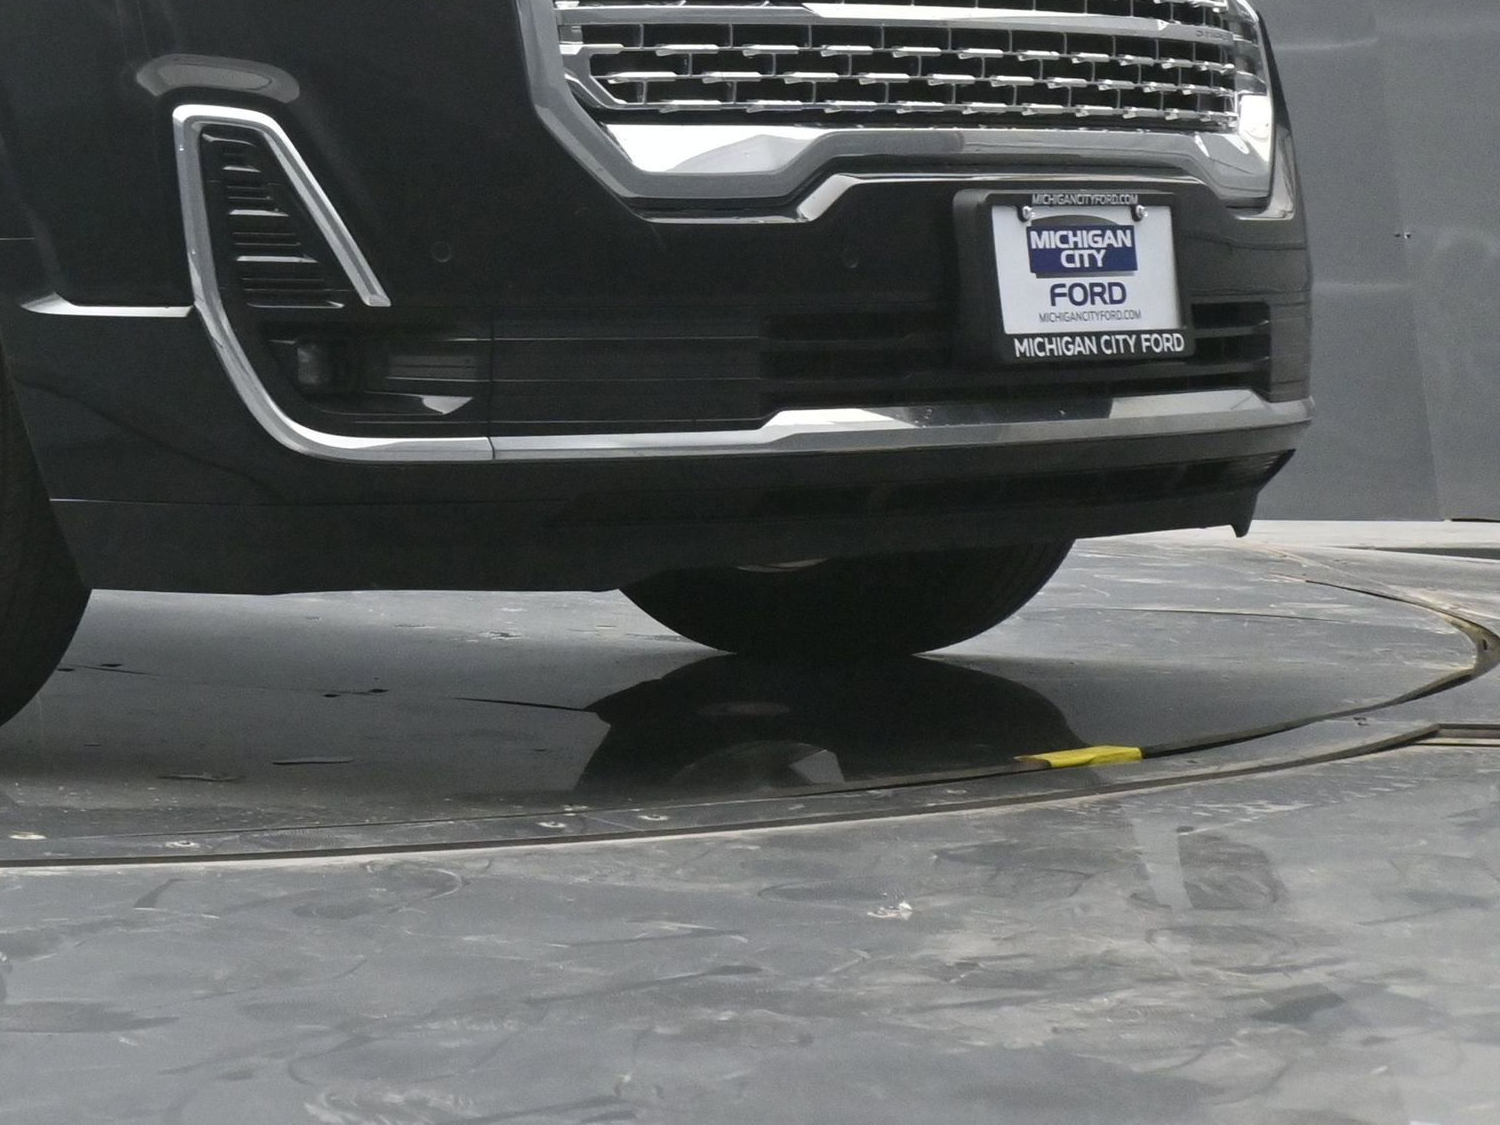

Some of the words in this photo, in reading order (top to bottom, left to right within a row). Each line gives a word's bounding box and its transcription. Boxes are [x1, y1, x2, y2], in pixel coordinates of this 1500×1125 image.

[1031, 193, 1139, 205] MICHIGANCITYFORD.COM
[1029, 229, 1133, 250] MICHIGAN
[1060, 249, 1107, 268] CITY
[1050, 281, 1127, 307] FORD
[1038, 309, 1142, 324] MICHIGANCITYFORD.COM
[1013, 335, 1098, 358] MICHIGAN
[1100, 334, 1136, 355] CITY
[1141, 332, 1186, 354] FORD
